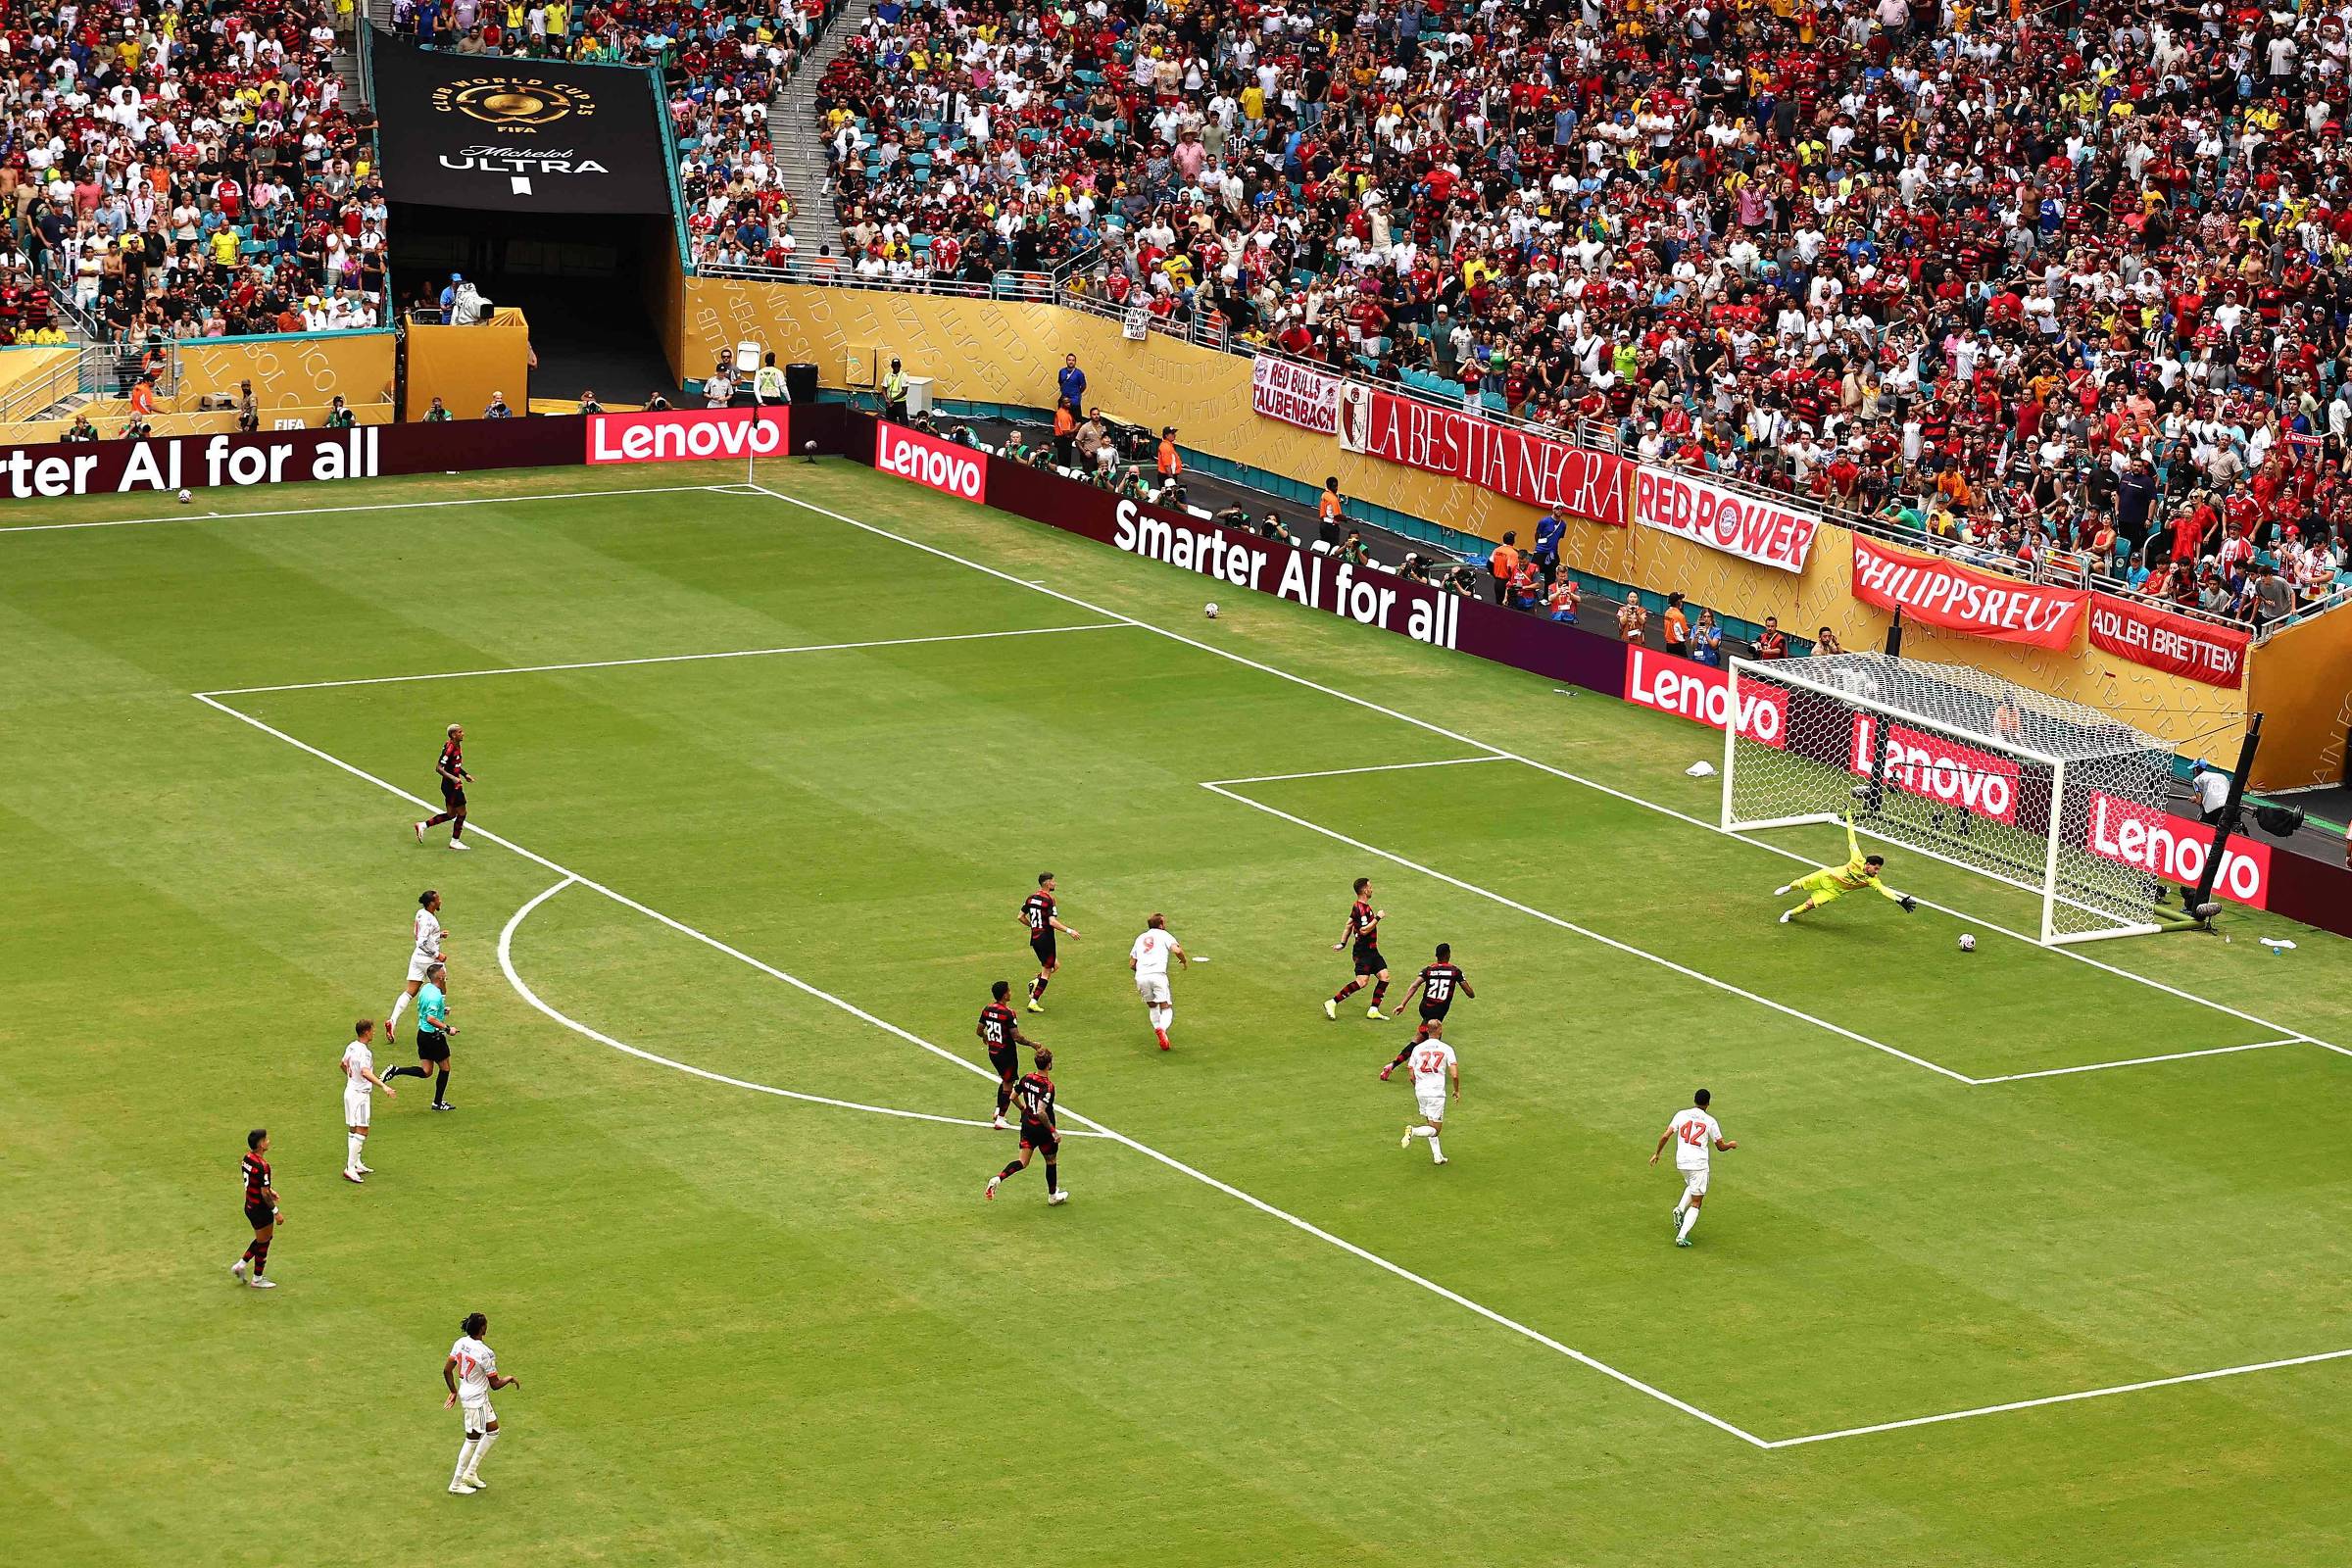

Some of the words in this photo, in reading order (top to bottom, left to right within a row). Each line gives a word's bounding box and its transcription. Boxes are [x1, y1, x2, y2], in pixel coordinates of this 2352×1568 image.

[432, 87, 453, 112] CLUB
[451, 76, 543, 88] WORLD
[553, 82, 592, 101] CUP
[439, 155, 610, 174] ULTRA
[460, 145, 574, 159] Michelob
[1270, 362, 1290, 389] RED
[1290, 367, 1322, 398] BULLS
[274, 418, 306, 430] FIFA
[1252, 384, 1337, 430] TAUBENBACH
[594, 415, 780, 460] Lenovo
[118, 439, 181, 493] AI
[205, 435, 294, 487] for
[312, 426, 378, 480] all
[878, 423, 981, 498] Lenovo
[1365, 393, 1402, 461] LA
[1408, 404, 1508, 494] BESTIA
[1515, 435, 1625, 523] NEGRA
[1637, 472, 1692, 530] RED
[1694, 491, 1814, 567] POWER
[1113, 500, 1267, 590] Smarter
[1277, 551, 1322, 609] AI
[1335, 562, 1396, 629] for
[1408, 589, 1459, 650] all
[1854, 547, 2077, 634] PHILIPPSREUT
[2091, 607, 2150, 649] ADLER
[2151, 626, 2238, 674] BRETTEN
[1631, 650, 1779, 740] Lenovo
[1857, 718, 2010, 815] Lenovo
[1029, 907, 1044, 928] 21
[1143, 936, 1154, 954] 9
[1427, 979, 1450, 1001] 26
[986, 1020, 1003, 1044] 29
[1420, 1052, 1445, 1073] 27
[1027, 1092, 1038, 1115] 4
[1680, 1120, 1707, 1147] 42
[456, 1352, 476, 1382] 17
